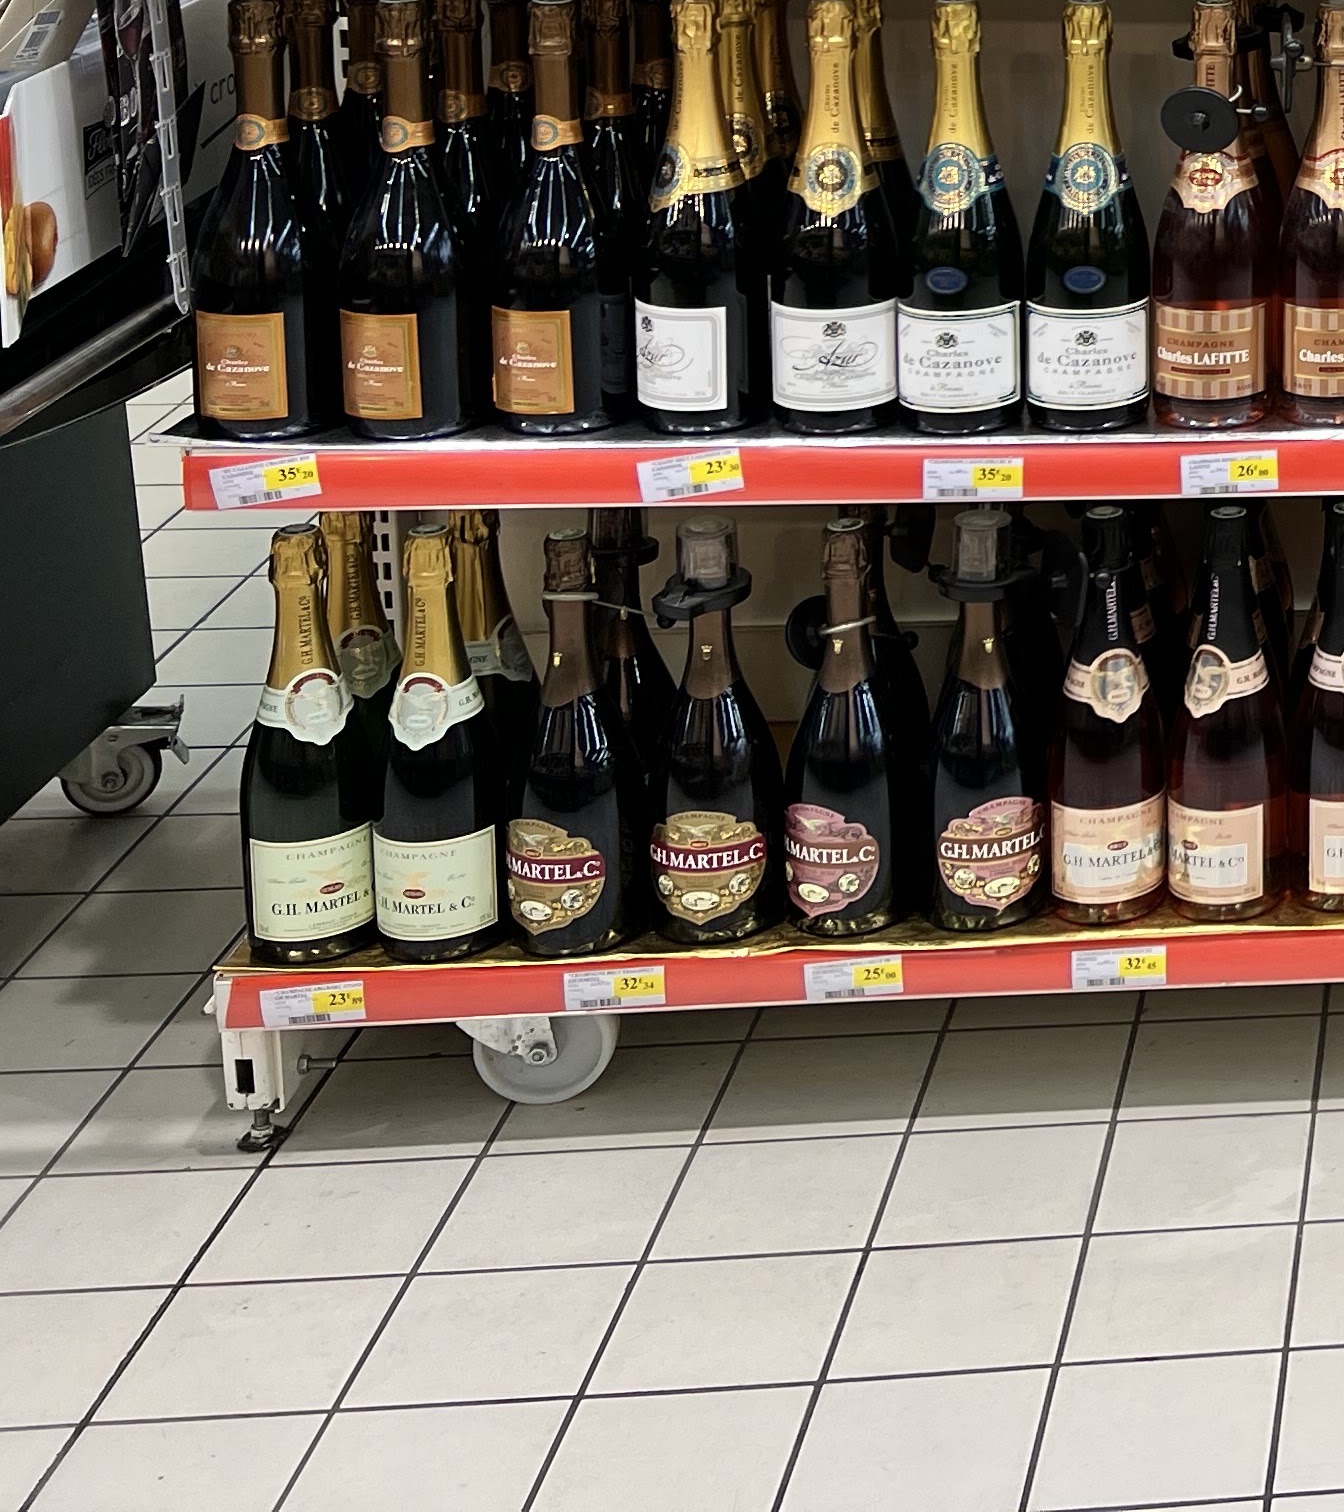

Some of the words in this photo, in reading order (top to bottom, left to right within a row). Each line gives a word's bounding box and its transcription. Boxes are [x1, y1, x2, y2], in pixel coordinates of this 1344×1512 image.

[904, 354, 915, 367] de
[920, 354, 1002, 369] Cazanove
[1051, 350, 1137, 366] Cazanove
[1157, 346, 1193, 364] Charles
[1194, 349, 1250, 364] LAFITTE
[217, 362, 270, 373] Cazanove
[272, 902, 302, 916] G.H.
[305, 893, 356, 914] MARTEL
[393, 901, 443, 915] MARTEL
[449, 903, 459, 912] &
